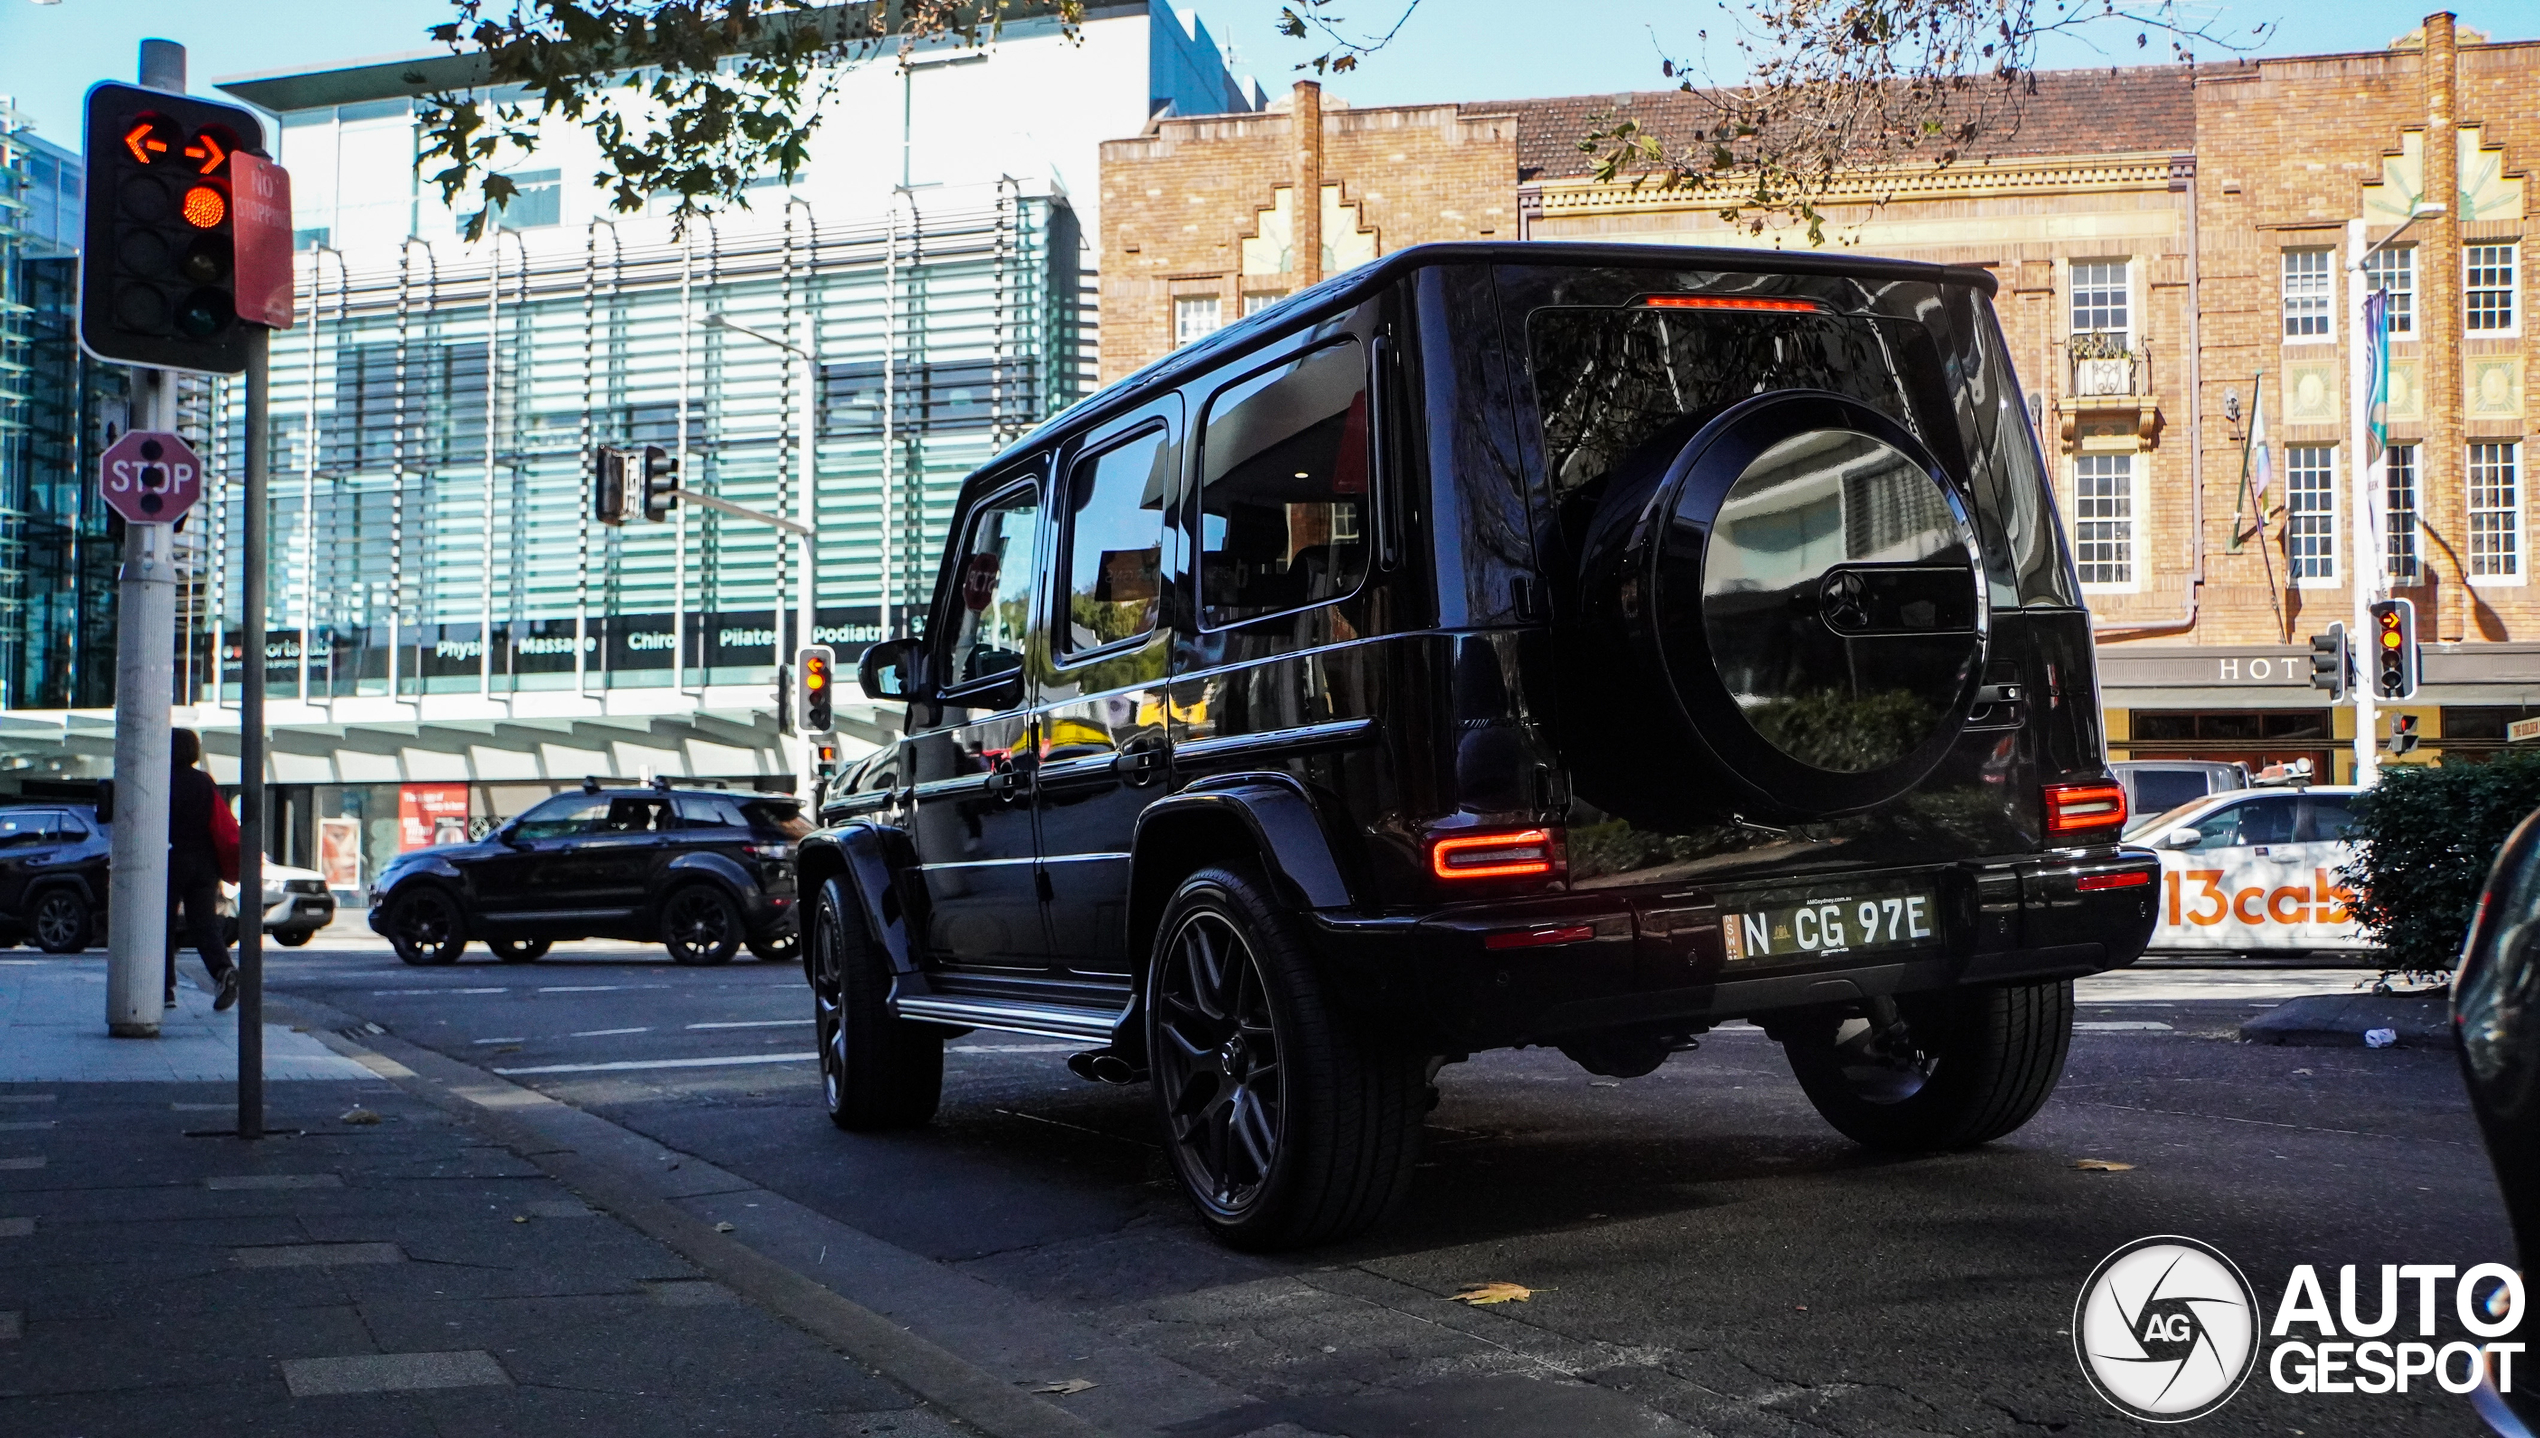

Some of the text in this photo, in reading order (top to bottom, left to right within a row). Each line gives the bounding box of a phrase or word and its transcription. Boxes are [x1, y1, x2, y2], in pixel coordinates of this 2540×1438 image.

[250, 169, 274, 198] NO
[110, 459, 194, 495] STOP
[436, 640, 493, 661] Physi
[628, 631, 677, 650] Chiro
[2219, 658, 2299, 681] HOT
[2163, 868, 2362, 925] 13cab
[1724, 915, 1736, 946] NSW
[1743, 896, 1931, 957] N CG 97E
